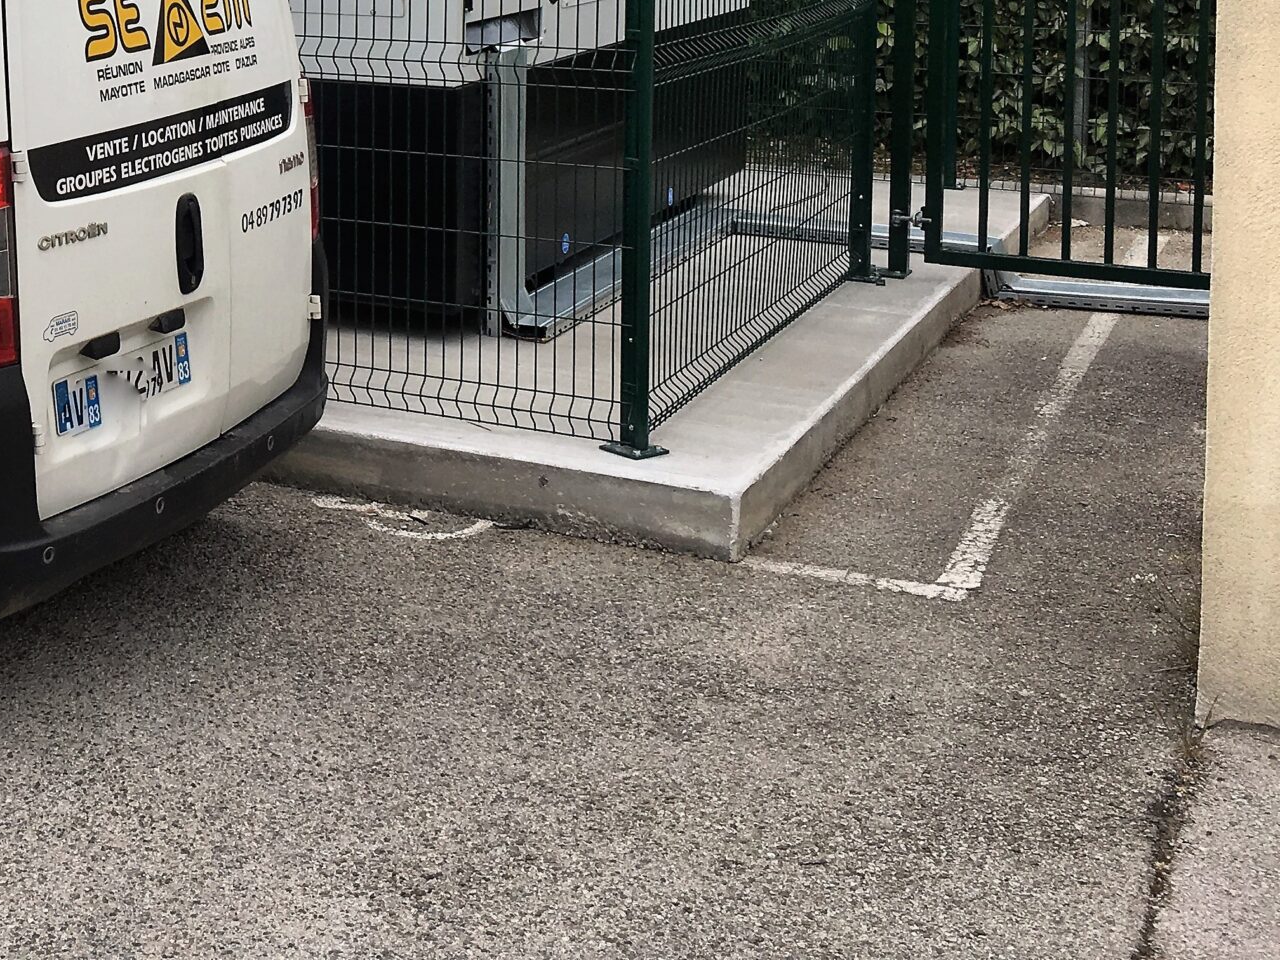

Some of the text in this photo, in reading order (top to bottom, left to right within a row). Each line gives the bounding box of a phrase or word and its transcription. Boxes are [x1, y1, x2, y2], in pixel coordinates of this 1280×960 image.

[240, 37, 256, 50] ALPES
[97, 60, 143, 82] RÉUNION
[100, 54, 258, 102] MAYOTTE MADAGASCAR COTE D'AZUR
[86, 136, 130, 161] VENTE
[142, 119, 196, 148] LOCATION
[206, 97, 266, 130] MAINTENANCE
[56, 113, 283, 195] GROUPES ELECTROGENES TOUTES PUISSANCES
[241, 189, 303, 233] 04 89 79 73 97
[177, 360, 190, 381] 83
[88, 404, 100, 424] 83
